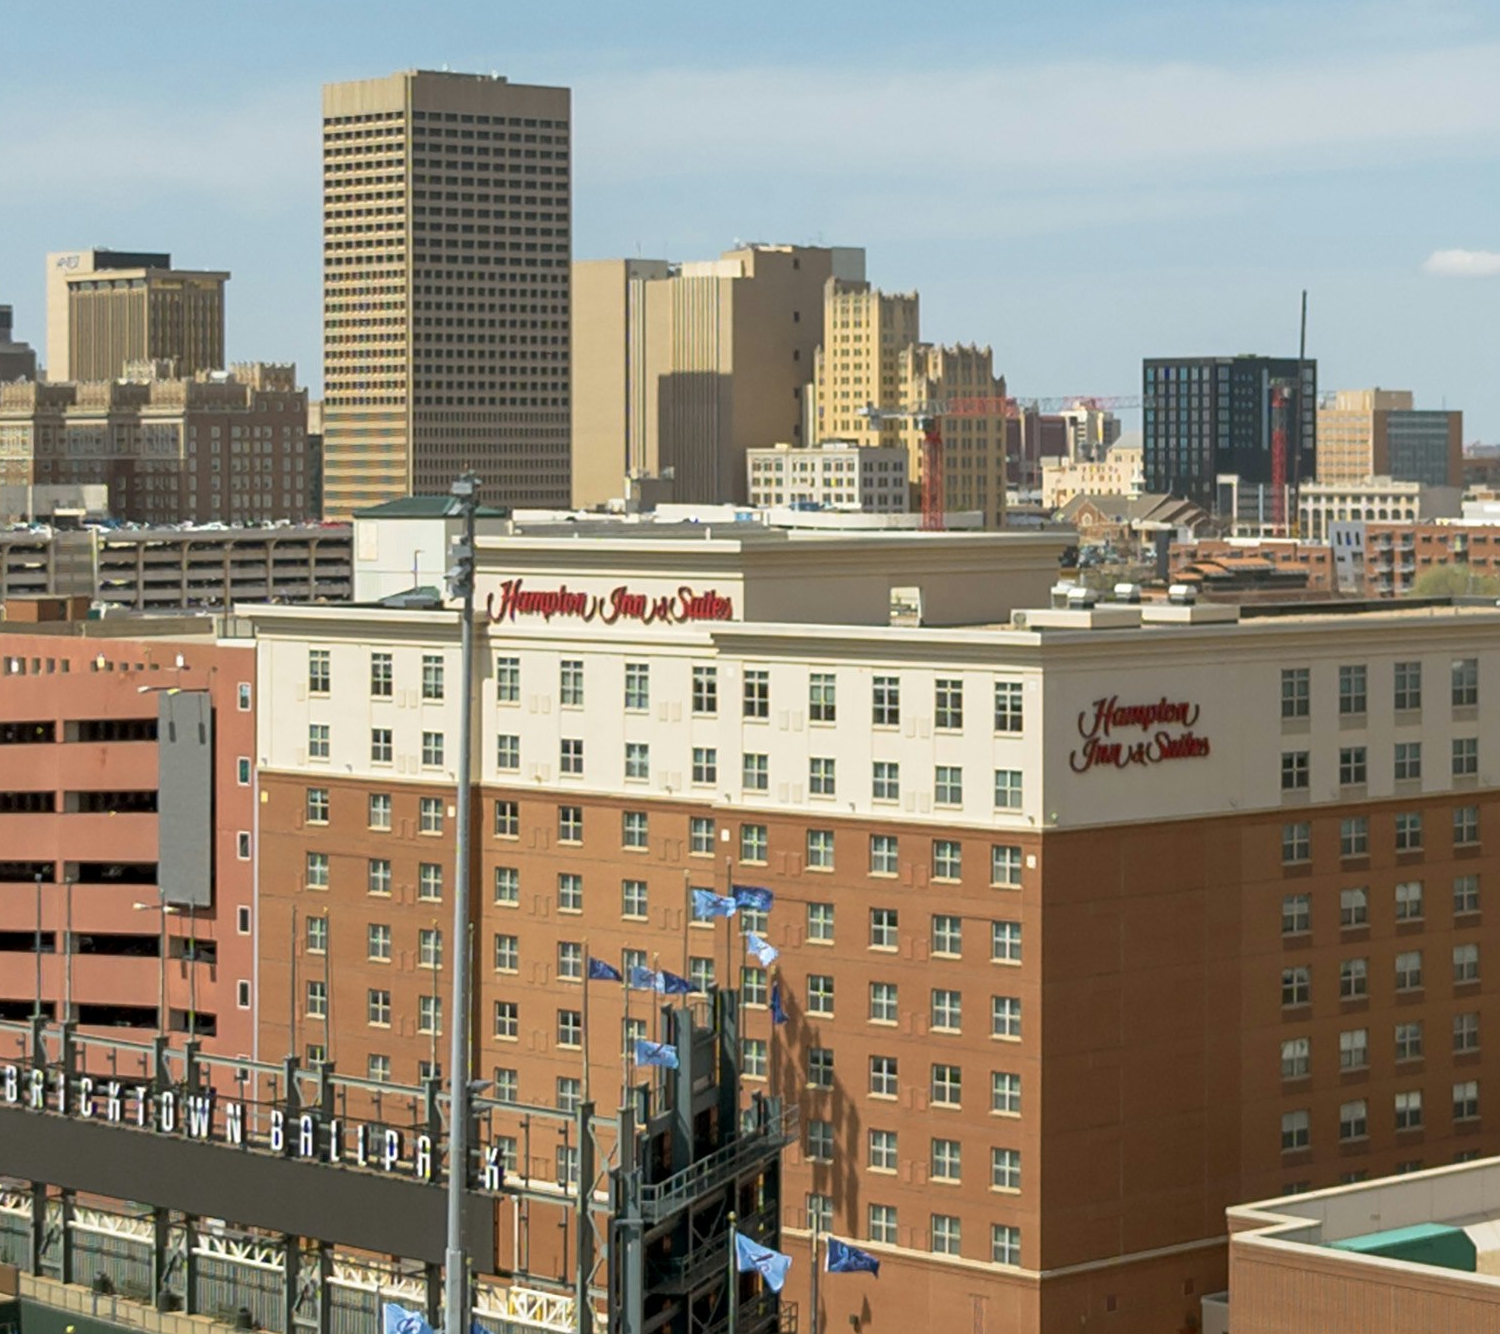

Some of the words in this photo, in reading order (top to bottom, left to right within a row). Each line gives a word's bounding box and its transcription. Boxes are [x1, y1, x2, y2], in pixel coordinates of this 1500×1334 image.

[487, 578, 597, 624] Hampton
[599, 585, 657, 625] Inn
[669, 586, 733, 624] Suites
[1078, 695, 1200, 739] Hampton
[1069, 737, 1133, 773] Inn
[1145, 731, 1210, 763] Suites
[4, 1064, 242, 1144] BRICKTOWN
[270, 1109, 500, 1191] BALLPAK
